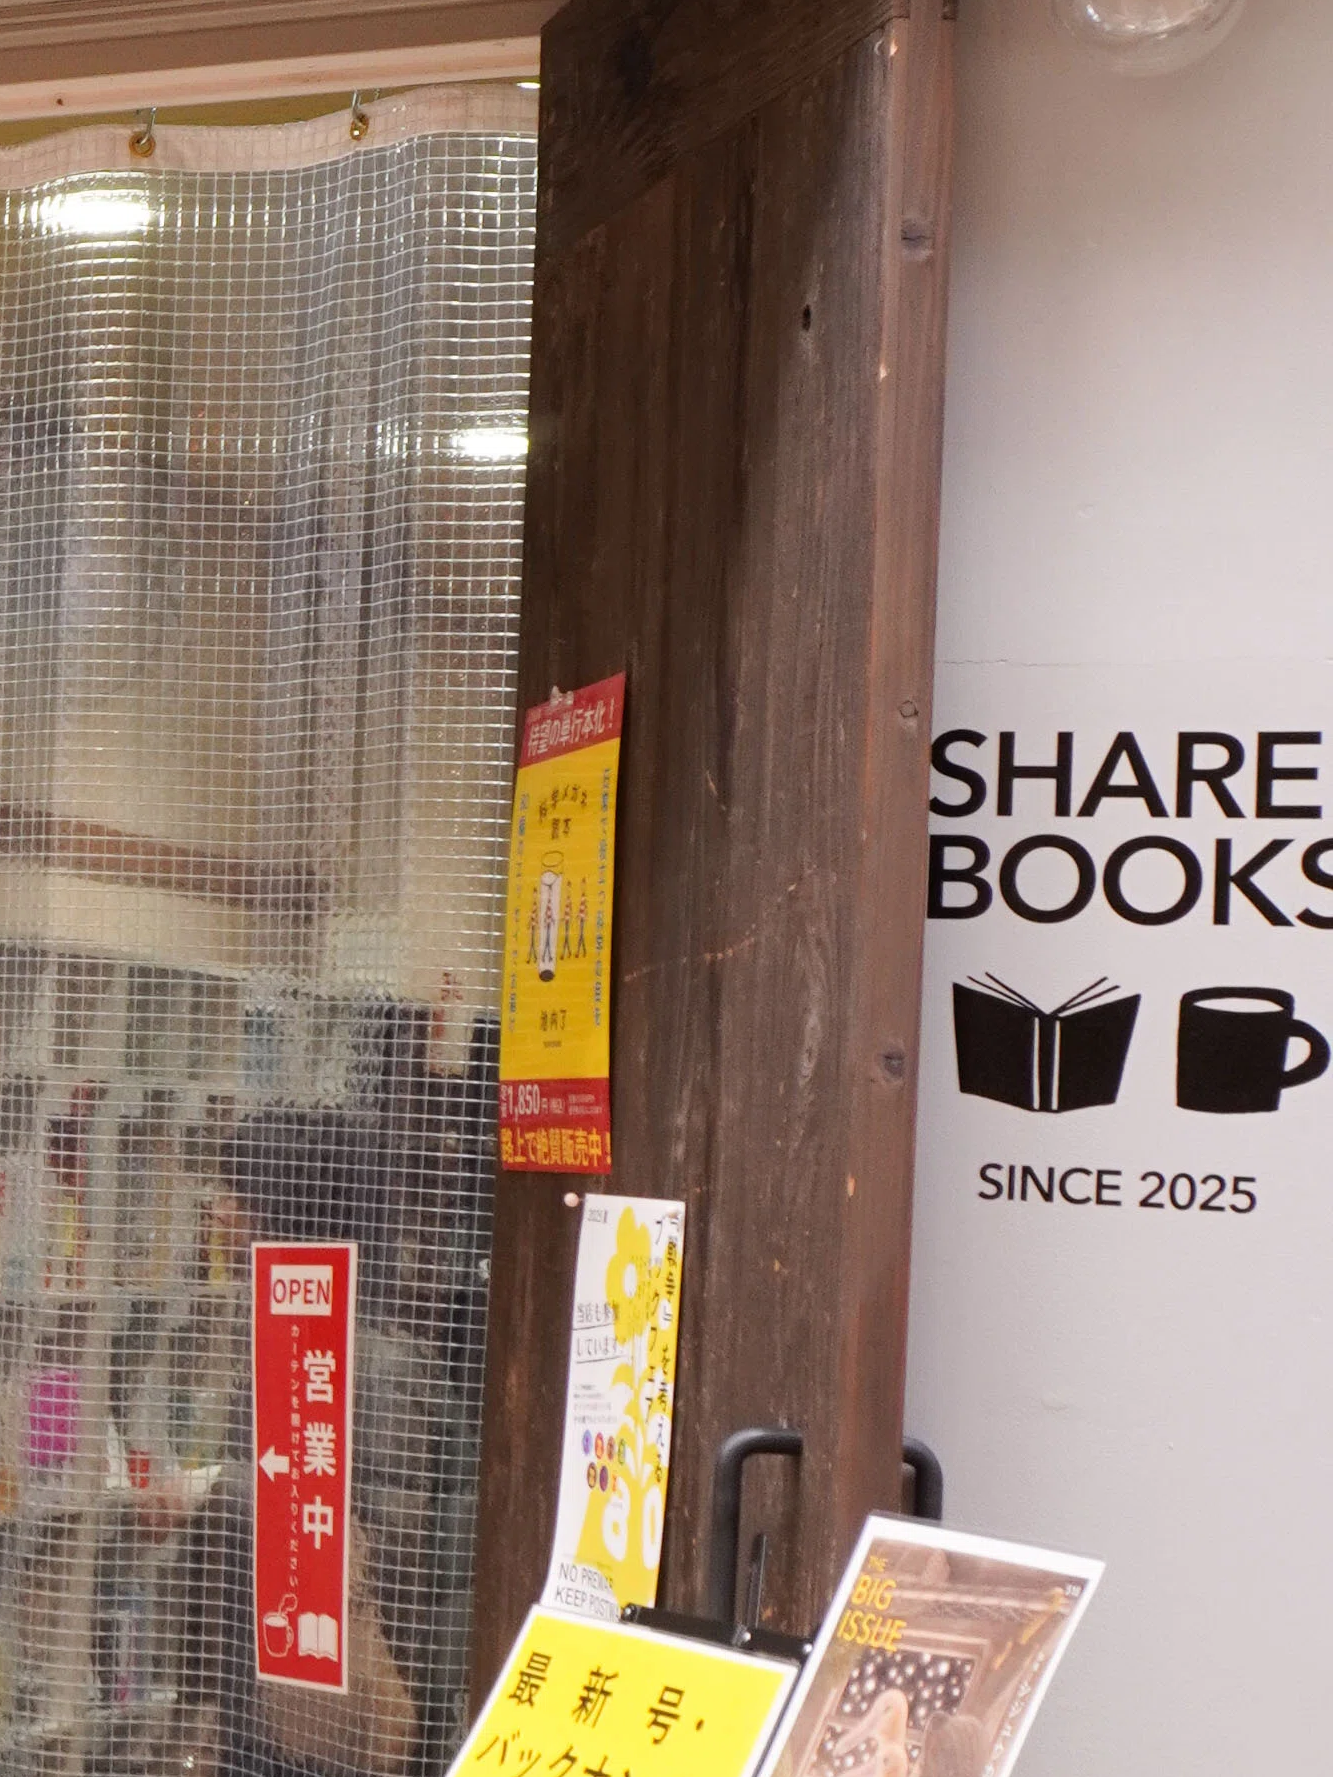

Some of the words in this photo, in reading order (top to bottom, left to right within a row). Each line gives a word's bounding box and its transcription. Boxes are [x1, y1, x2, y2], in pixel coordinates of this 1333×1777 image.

[929, 729, 1323, 819] SHARE
[977, 1162, 1123, 1207] SINCE
[1138, 1171, 1258, 1214] 2025
[273, 1277, 332, 1305] OPEN
[302, 1348, 337, 1550] 営業中
[558, 1562, 578, 1583] NO
[868, 1556, 889, 1572] THE
[555, 1585, 587, 1607] KEEP
[851, 1574, 897, 1611] BIG
[837, 1610, 907, 1652] ISSUE
